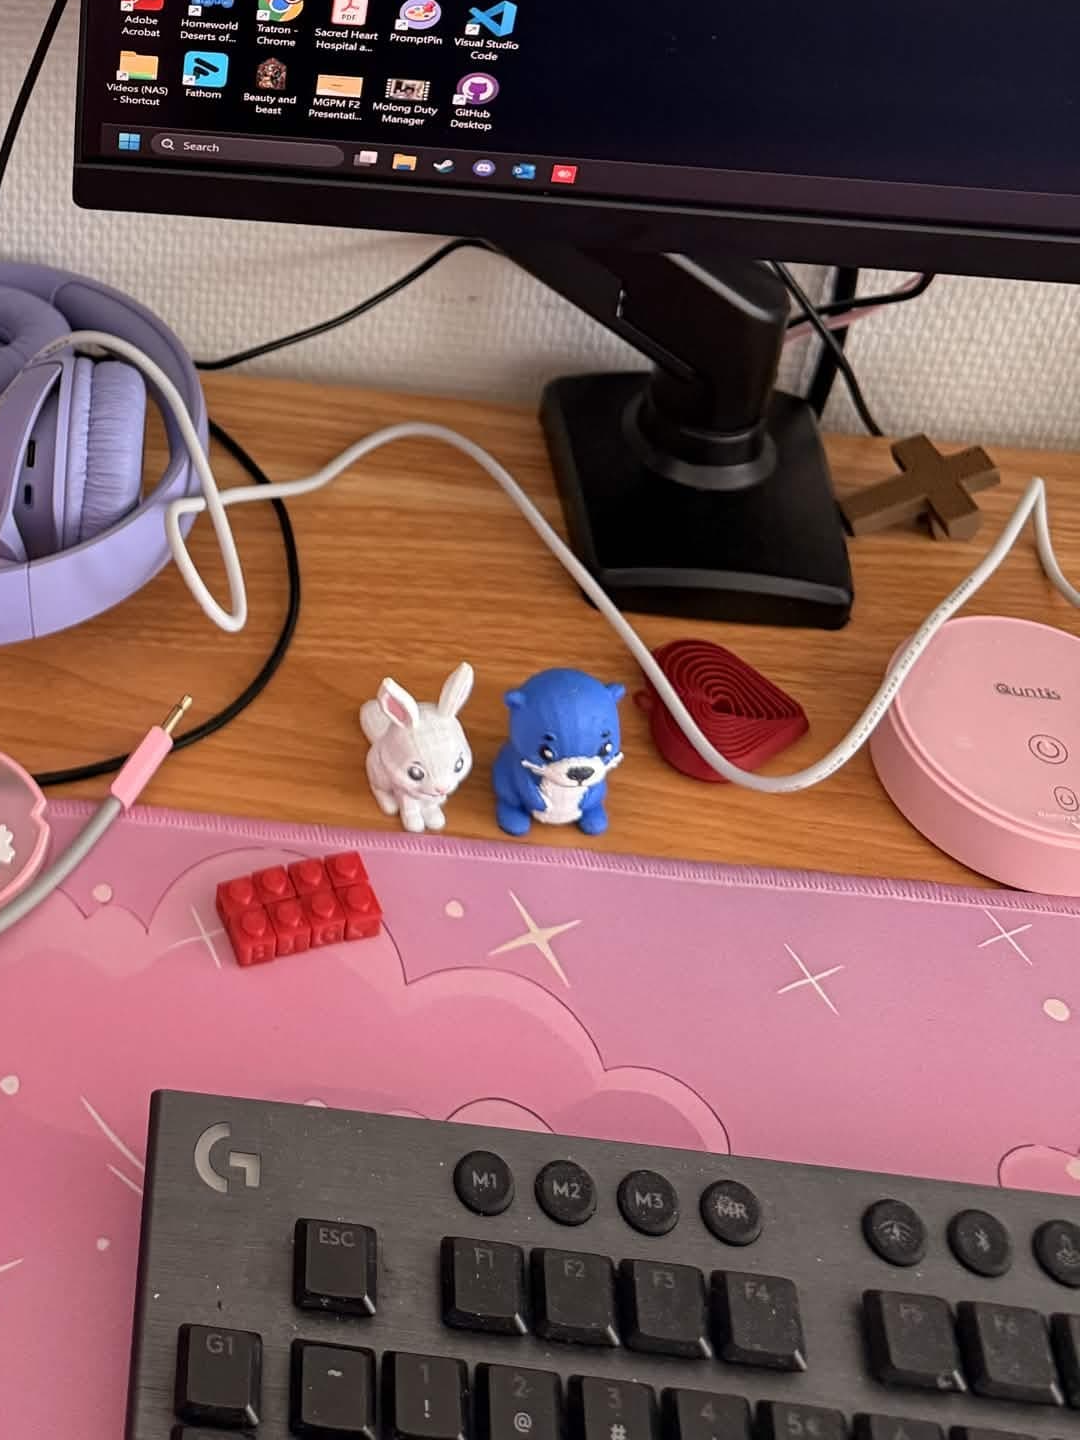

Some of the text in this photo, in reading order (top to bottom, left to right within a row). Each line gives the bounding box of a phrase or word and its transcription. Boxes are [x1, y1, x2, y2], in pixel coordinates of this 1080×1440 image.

[125, 15, 158, 25] Adobe
[181, 19, 238, 30] Homeworld
[122, 27, 160, 37] Acrobat
[180, 31, 215, 42] Deserts
[315, 28, 378, 40] Sacred Heart
[257, 37, 296, 47] Chrome
[390, 33, 443, 44] PromptPin
[454, 37, 519, 50] Visual Studio
[316, 40, 357, 51] Hospital
[470, 51, 498, 60] Code
[107, 83, 168, 96] Videos (NAS)
[185, 89, 222, 98] Fathom
[120, 95, 160, 106] Shortcut
[243, 93, 275, 104] Beauty
[313, 98, 345, 109] MGPM
[256, 104, 282, 114] beast
[372, 102, 438, 116] Molong Duty
[455, 108, 491, 119] GitHub
[381, 114, 425, 126] Manager
[450, 120, 492, 131] Desktop
[183, 142, 220, 152] Search
[995, 682, 1062, 702] Quntis
[471, 1168, 497, 1189] M1
[552, 1178, 581, 1200] M2
[635, 1191, 664, 1211] M3
[319, 1227, 355, 1248] ESC
[474, 1247, 495, 1268] F1
[563, 1259, 585, 1279] F2
[653, 1270, 675, 1290] F3
[206, 1335, 234, 1356] G1
